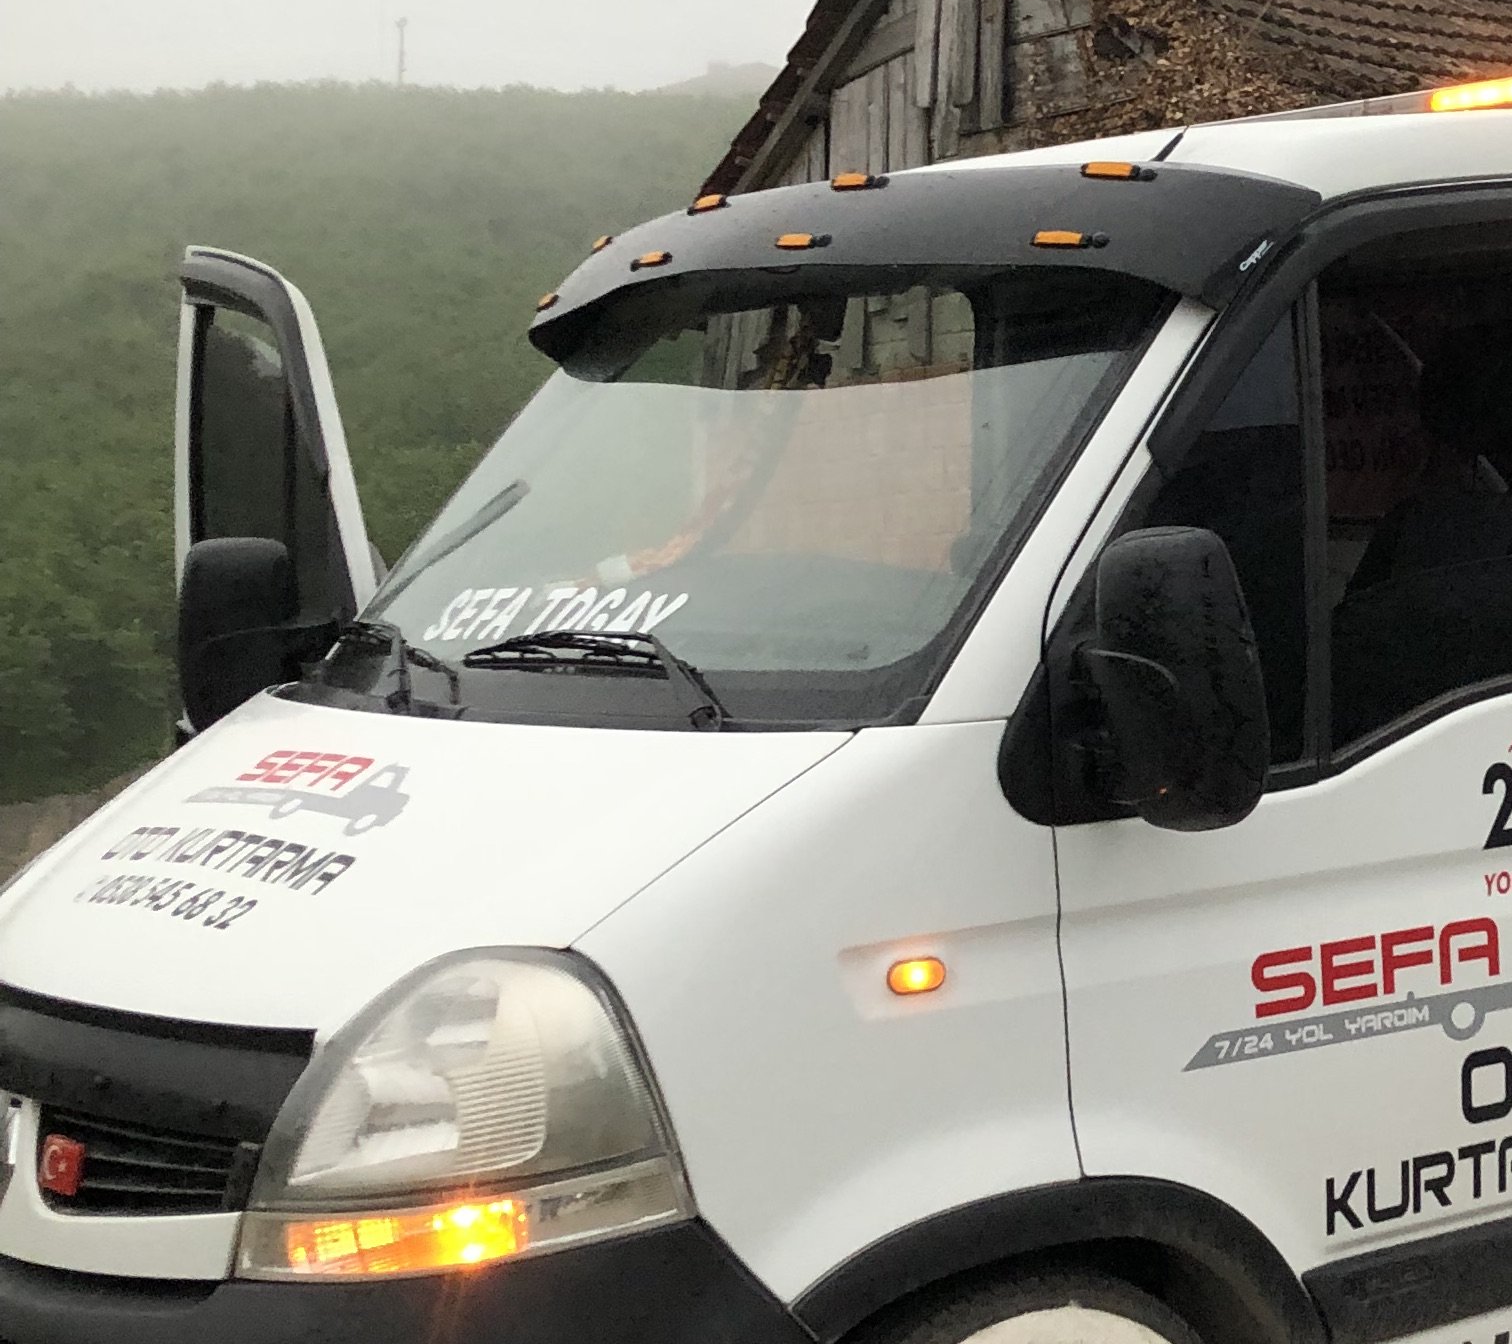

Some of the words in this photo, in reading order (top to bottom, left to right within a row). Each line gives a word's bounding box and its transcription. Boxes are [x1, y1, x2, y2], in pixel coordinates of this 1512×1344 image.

[422, 587, 532, 641] SEFA
[235, 750, 375, 791] SEFA
[157, 827, 356, 895] KURTARMA
[171, 888, 226, 920] 68
[203, 896, 258, 930] 32
[1251, 917, 1500, 1019] SEFA
[1214, 1032, 1273, 1060] 7/24
[1284, 1023, 1333, 1046] YOL
[1344, 1005, 1430, 1034] YARDIM
